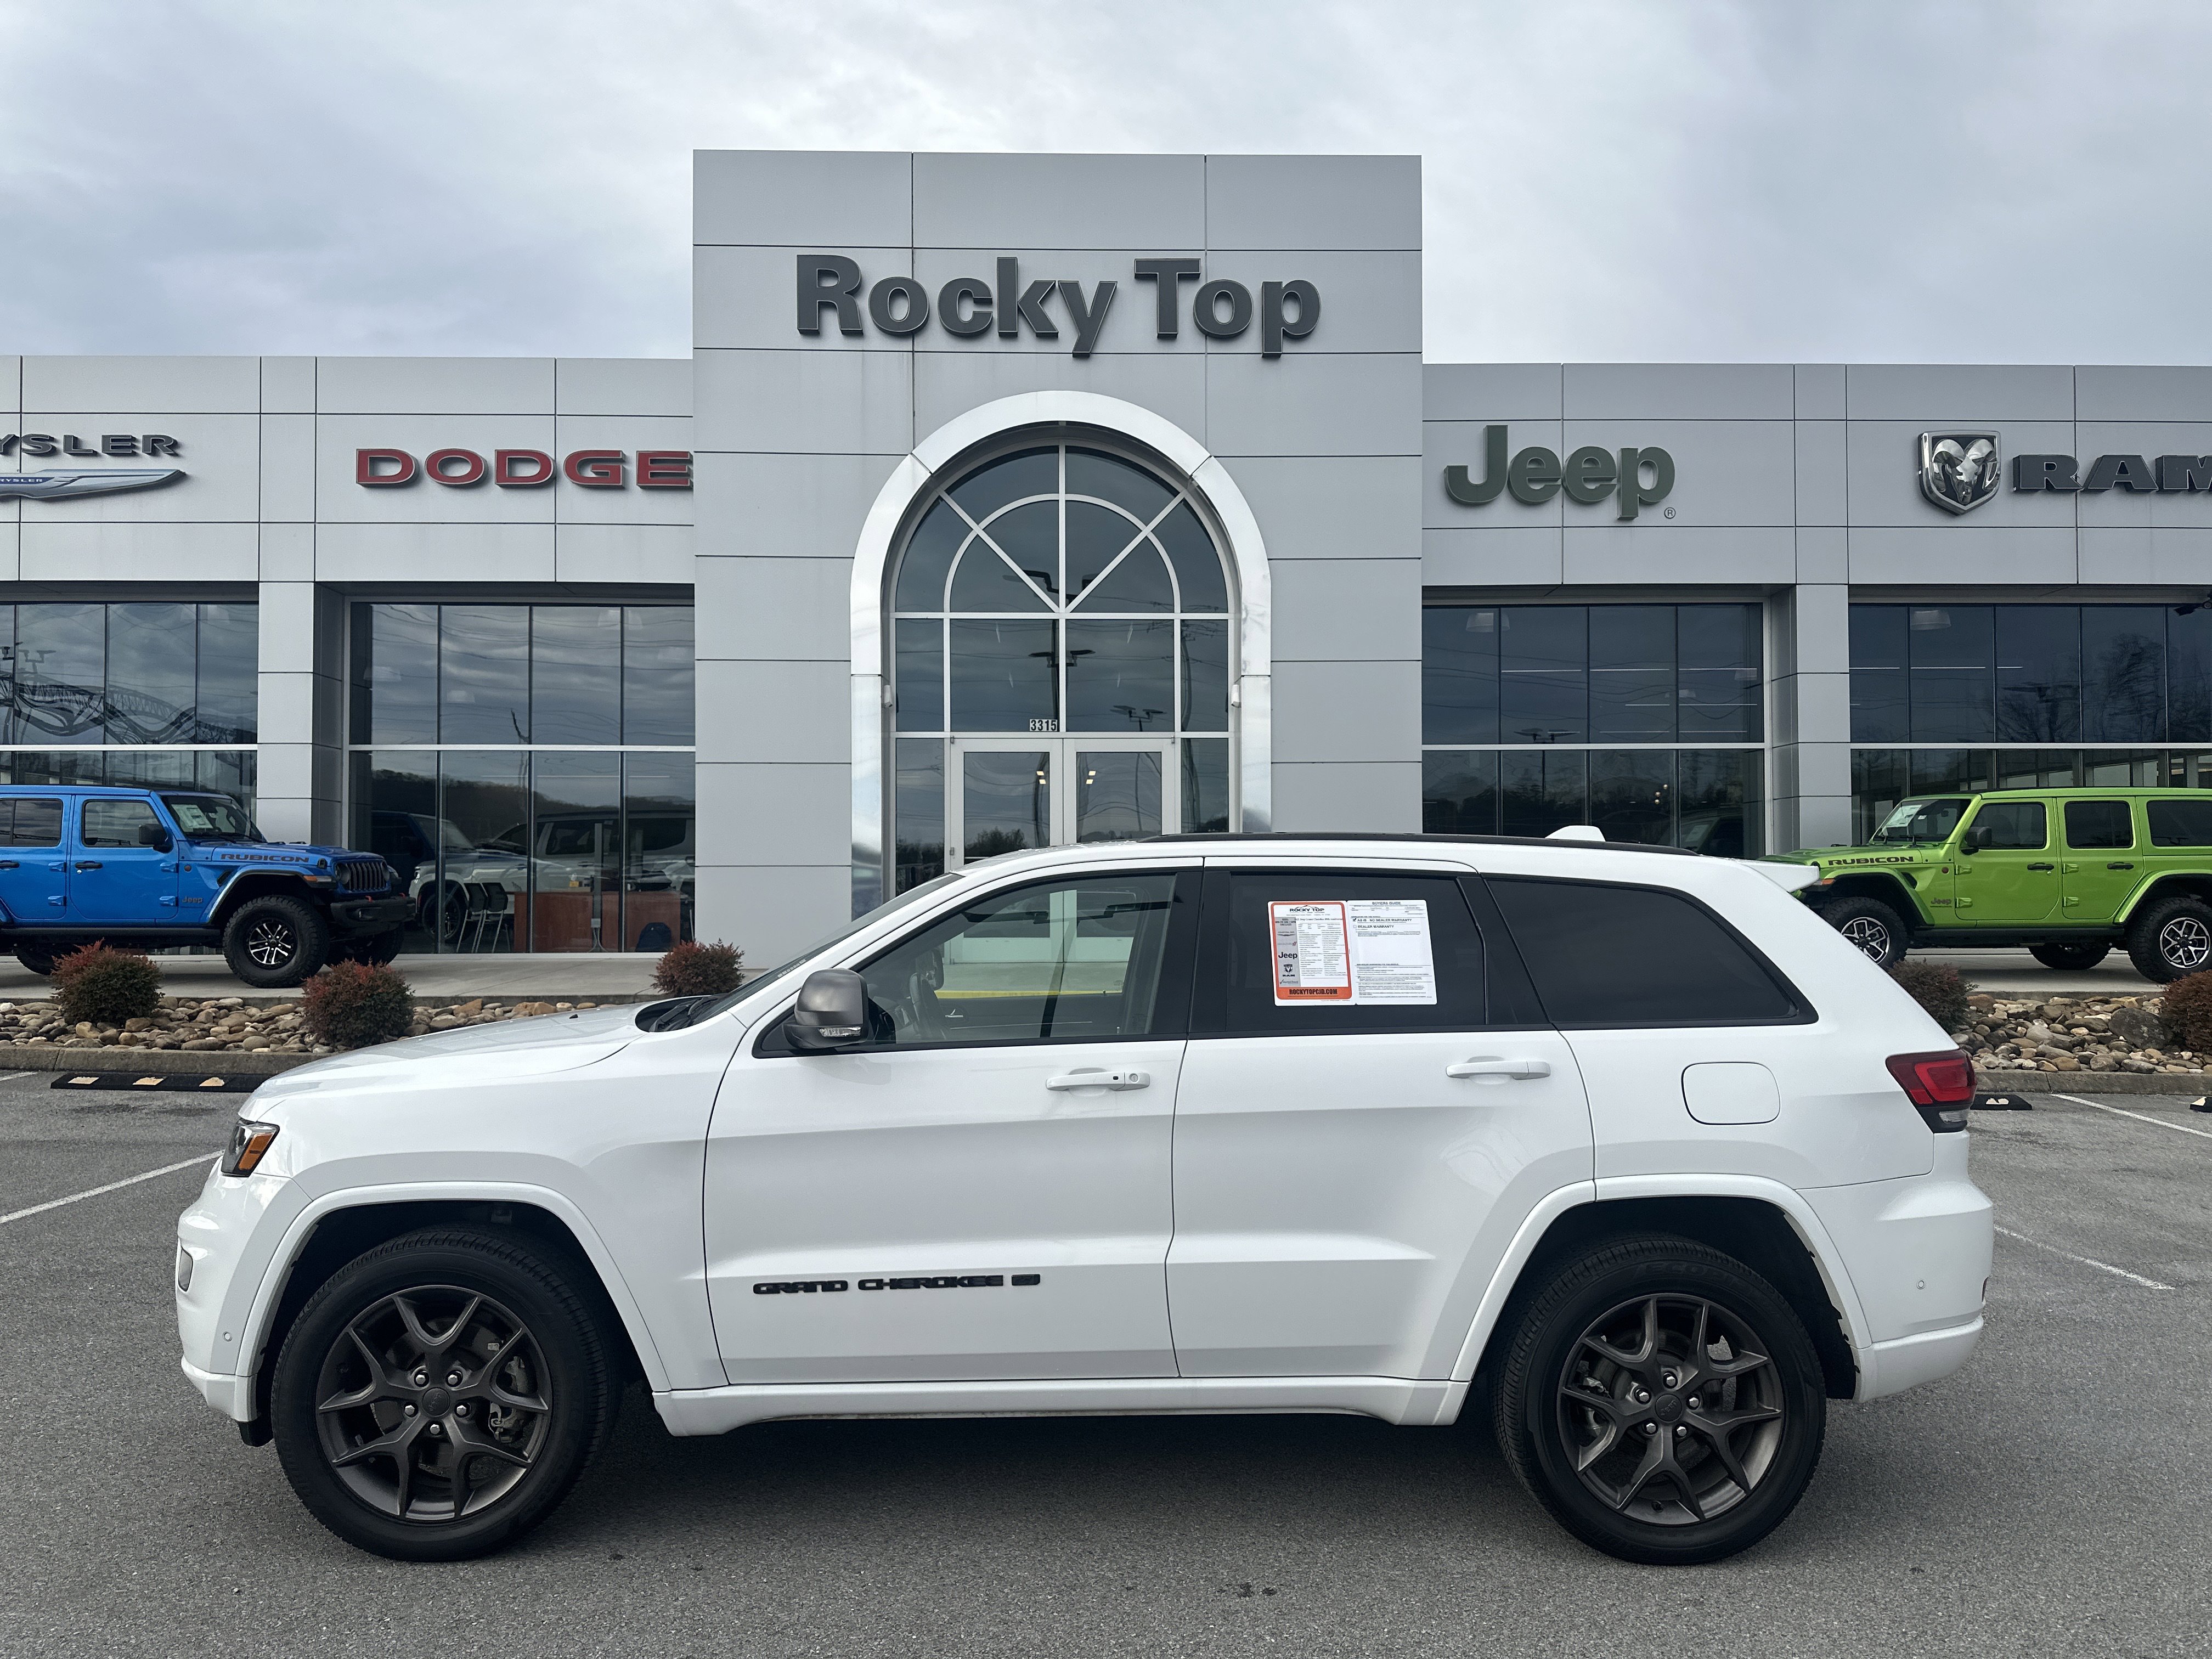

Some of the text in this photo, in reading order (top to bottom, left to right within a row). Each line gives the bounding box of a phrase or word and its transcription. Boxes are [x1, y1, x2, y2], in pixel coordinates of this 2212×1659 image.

[796, 254, 1321, 358] Rocky Top
[356, 448, 693, 489] DODGE
[1444, 425, 1675, 520] Jeep
[2012, 454, 2212, 493] RAM
[1030, 720, 1057, 731] 3315
[221, 854, 309, 862] RUBICON
[1828, 856, 1914, 866] RUBICON
[753, 1280, 848, 1294] GRAND
[857, 1275, 1003, 1290] CHEROKEE
